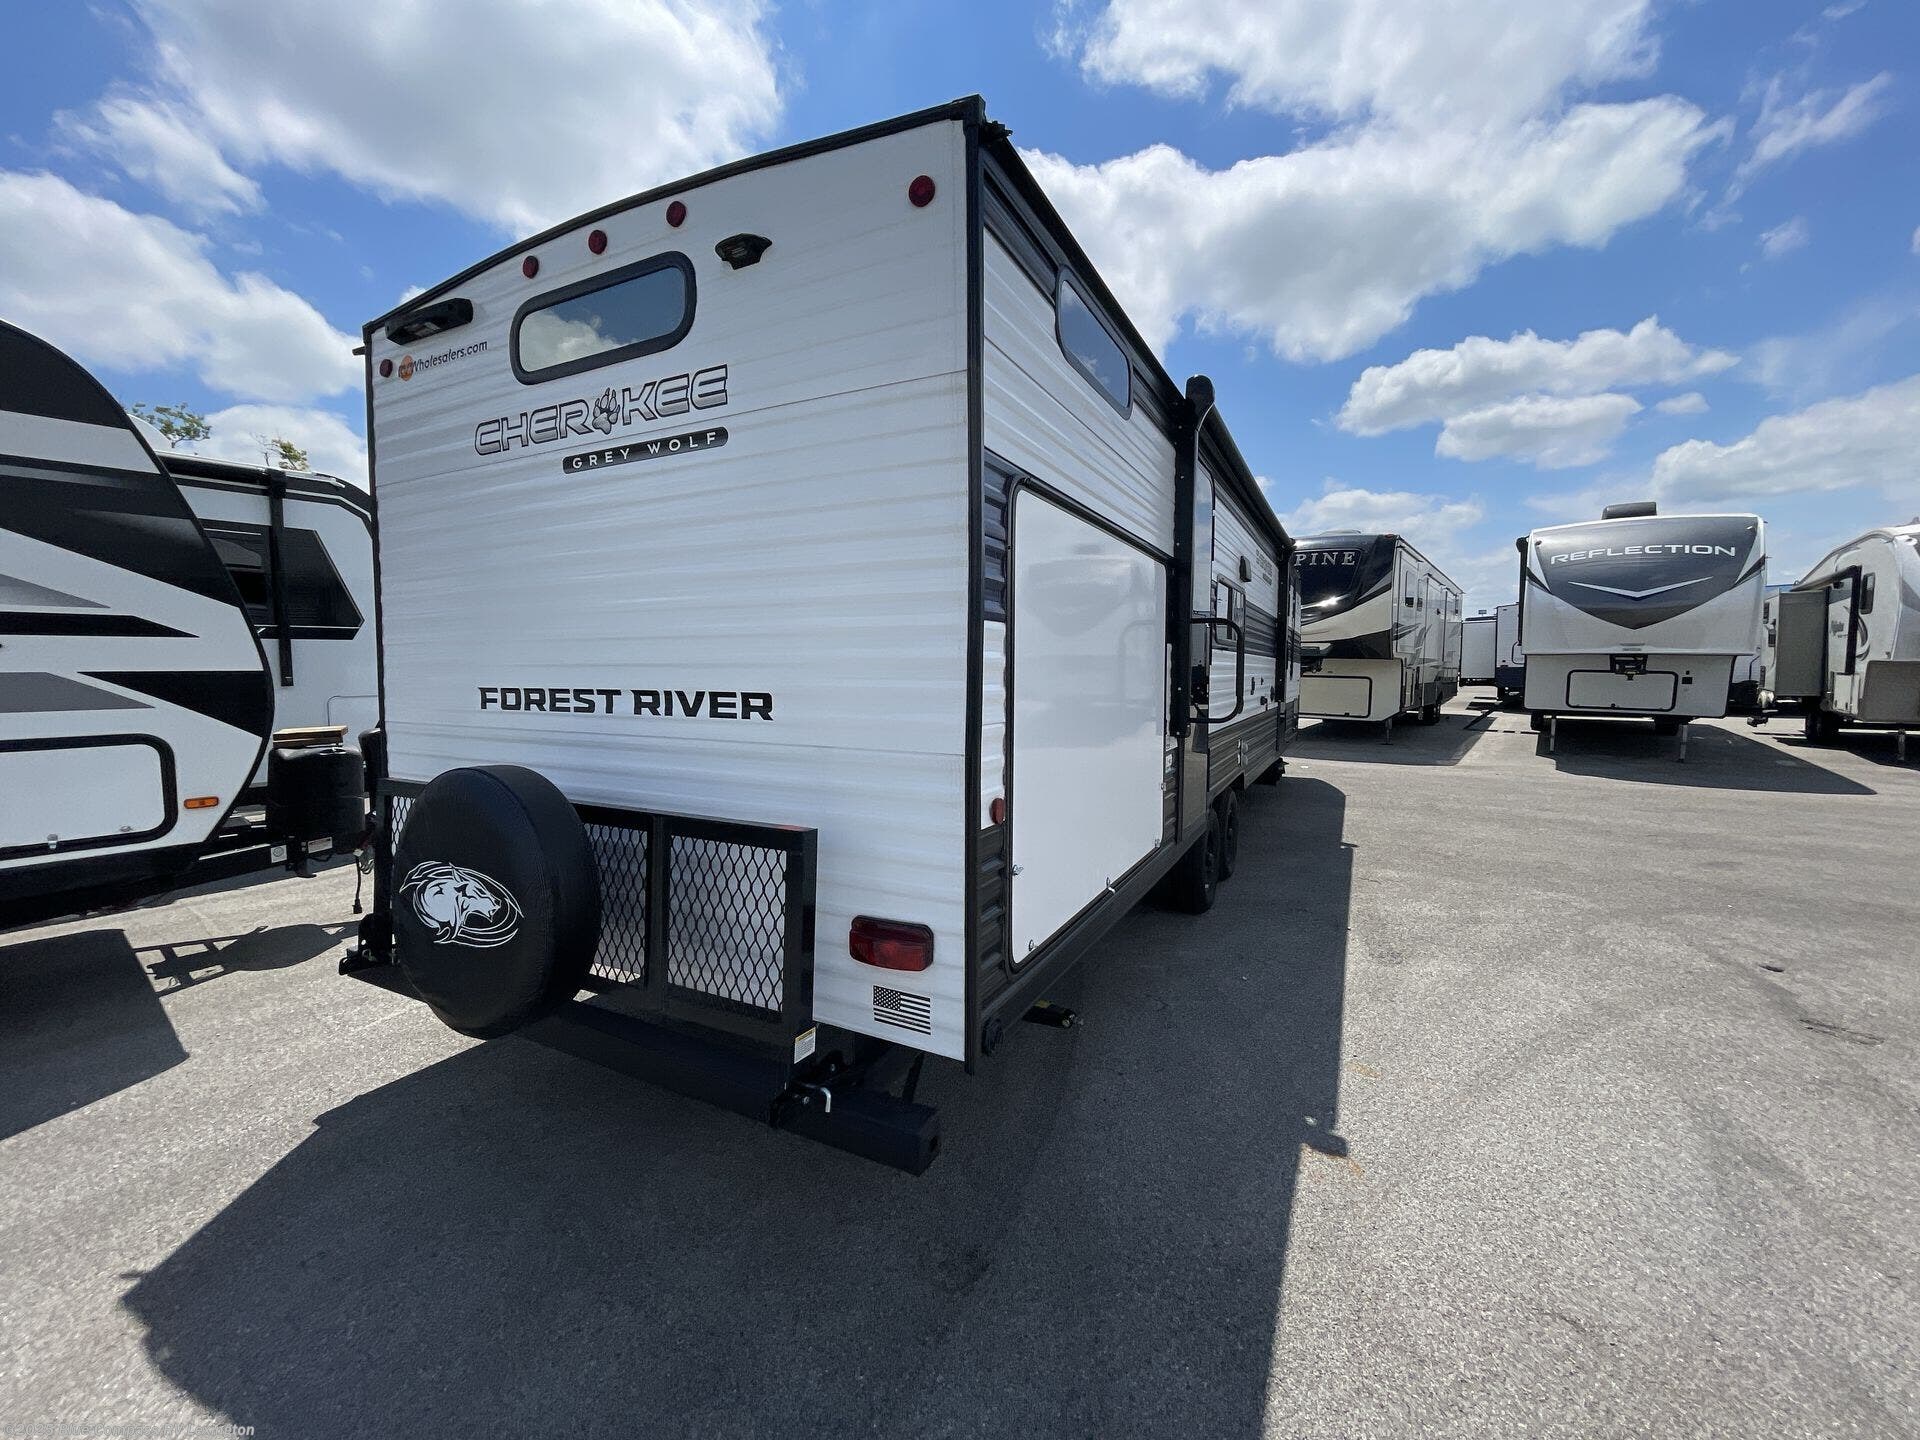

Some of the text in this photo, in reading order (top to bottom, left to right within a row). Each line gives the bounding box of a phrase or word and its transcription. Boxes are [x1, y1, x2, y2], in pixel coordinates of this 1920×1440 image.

[572, 431, 717, 469] GREY WOLF
[1550, 544, 1736, 565] REFLECTION
[478, 686, 774, 721] FOREST RIVER
